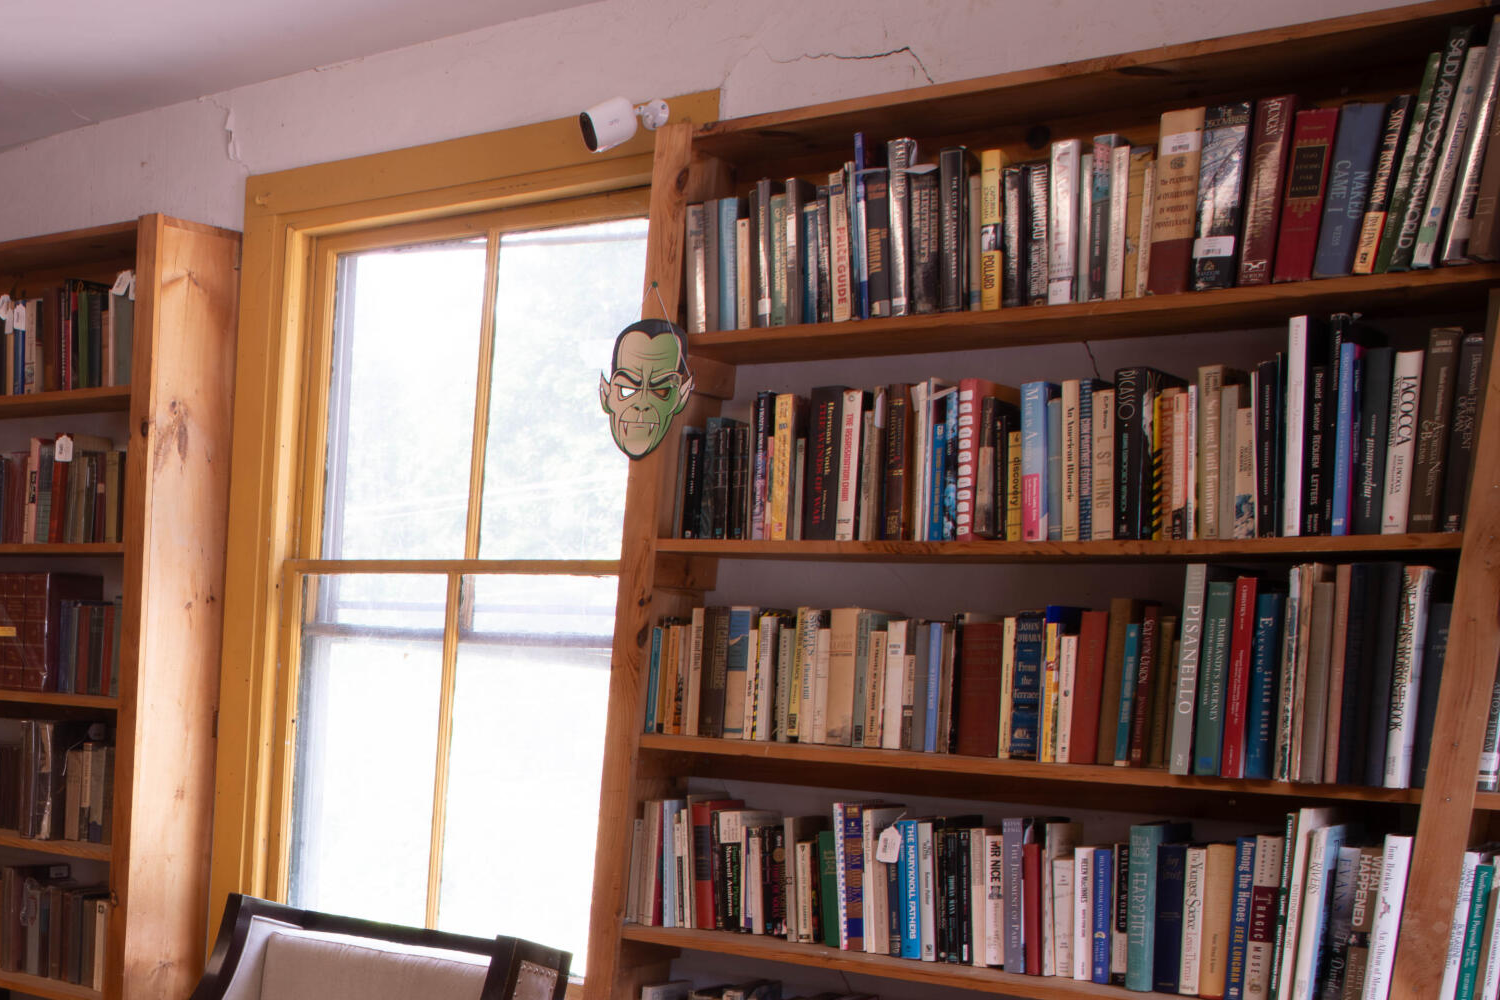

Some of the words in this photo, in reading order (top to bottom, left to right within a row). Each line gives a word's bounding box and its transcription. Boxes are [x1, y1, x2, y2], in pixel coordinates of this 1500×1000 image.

[1387, 108, 1402, 131] SON
[1425, 78, 1453, 147] ARAMCO
[1329, 160, 1351, 200] CAME
[1371, 150, 1394, 205] ROSEMARY
[1346, 170, 1368, 219] NAKED
[1332, 225, 1341, 246] WEISS
[1397, 196, 1421, 249] WORLD
[836, 227, 846, 262] PRICE
[837, 265, 847, 305] GUIDE
[983, 255, 994, 290] POLLARD
[1117, 369, 1139, 420] PICASSO
[1314, 372, 1324, 400] Ronald
[825, 402, 836, 444] Herman
[846, 414, 854, 427] THE
[1067, 407, 1075, 418] An
[1312, 402, 1323, 431] Senator
[1396, 376, 1419, 448] IACOCCA
[1066, 420, 1075, 462] American
[1203, 419, 1217, 447] Long
[823, 446, 833, 476] Wouk
[1310, 434, 1321, 469] REQUIEM
[1011, 457, 1021, 506] discovery
[1066, 464, 1074, 501] Rhetoric
[1309, 473, 1320, 506] LETTERS
[811, 497, 821, 525] WAR
[1204, 475, 1217, 525] Tomorrow
[1239, 585, 1248, 617] CHRISTIE'S
[1177, 604, 1204, 714] PISANELLO
[1213, 617, 1227, 679] REMBRANDT'S
[1255, 616, 1274, 673] EVENING
[1209, 681, 1221, 721] JOURNEY
[1388, 703, 1404, 733] BOOK
[907, 824, 916, 843] THE
[990, 841, 1001, 857] MR
[726, 846, 734, 877] Maxwell
[852, 845, 864, 868] TOM
[1011, 842, 1021, 860] THE
[1081, 859, 1089, 875] HELEN
[1238, 841, 1255, 872] Among
[1389, 845, 1398, 862] Tom
[908, 846, 917, 899] MARYKNOLL
[990, 860, 1001, 883] NICE
[1010, 863, 1021, 907] JUDGMENT
[1188, 861, 1204, 897] Youngest
[1239, 874, 1251, 889] the
[1307, 861, 1321, 896] RIVERS
[1368, 855, 1383, 892] WHAT
[1383, 863, 1395, 893] Brokaw
[1475, 871, 1489, 902] Nonfiction
[726, 879, 734, 917] Anderson
[1131, 872, 1148, 904] FEAR
[1351, 854, 1373, 926] HAPPENED
[908, 900, 918, 940] FATHERS
[1097, 904, 1105, 929] CLINTON
[1119, 894, 1128, 928] WORLD
[1186, 898, 1203, 931] Science
[1235, 891, 1250, 922] Heroes
[1473, 903, 1484, 918] Book
[1011, 924, 1021, 949] PARIS
[1186, 932, 1197, 951] Lewis
[1234, 925, 1245, 943] JERE
[1333, 931, 1349, 953] The
[1468, 920, 1481, 948] Proposals
[1184, 951, 1196, 982] Thomas
[1230, 946, 1243, 983] LONGMAN
[1250, 946, 1262, 973] MUSE
[1375, 943, 1386, 966] Album
[1328, 959, 1345, 993] Divide
[1344, 952, 1357, 1000] McCLELLAN
[1356, 964, 1366, 990] SCOTT
